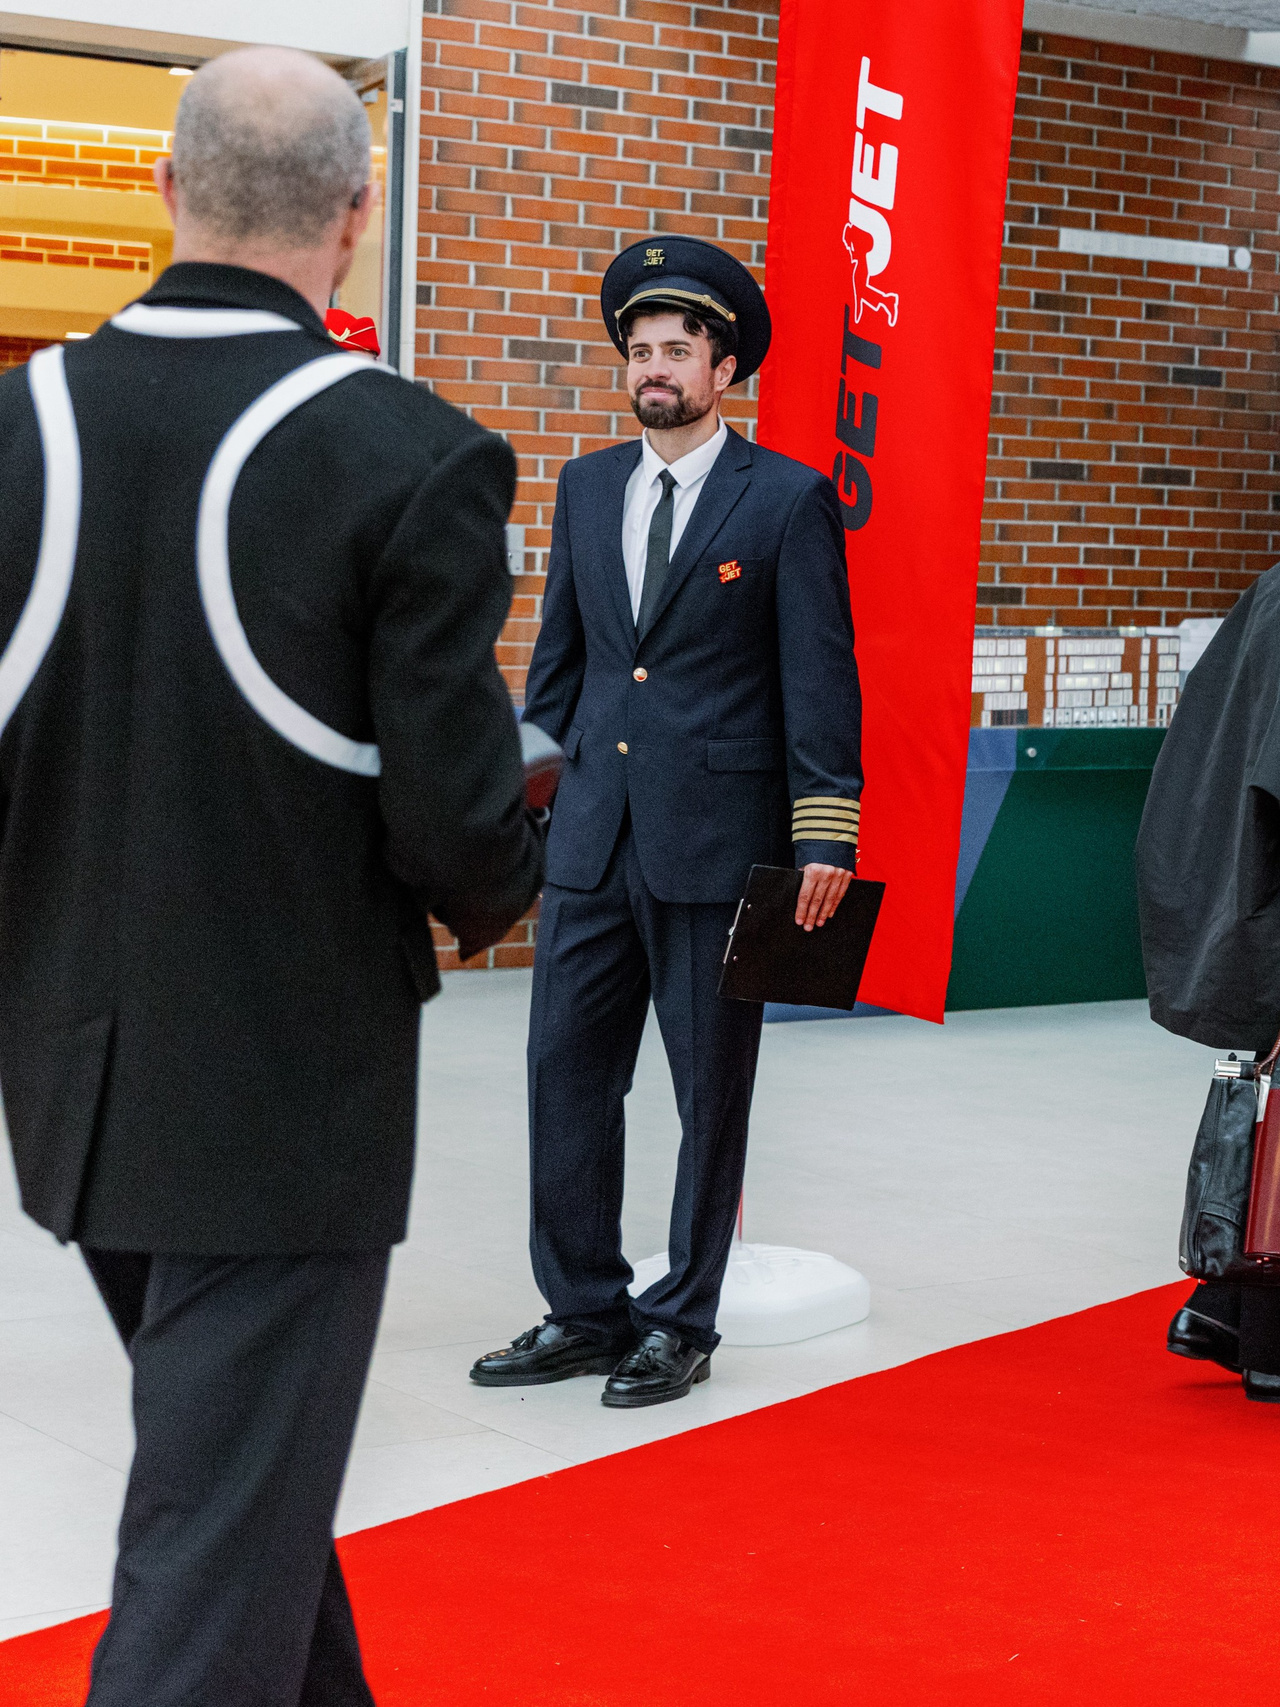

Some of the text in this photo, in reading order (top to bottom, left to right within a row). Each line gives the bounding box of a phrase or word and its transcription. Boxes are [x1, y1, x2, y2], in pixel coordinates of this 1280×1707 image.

[646, 248, 663, 257] GET
[647, 257, 665, 265] JET
[832, 55, 904, 532] GET JET
[719, 561, 737, 573] GET
[724, 568, 741, 580] JET
